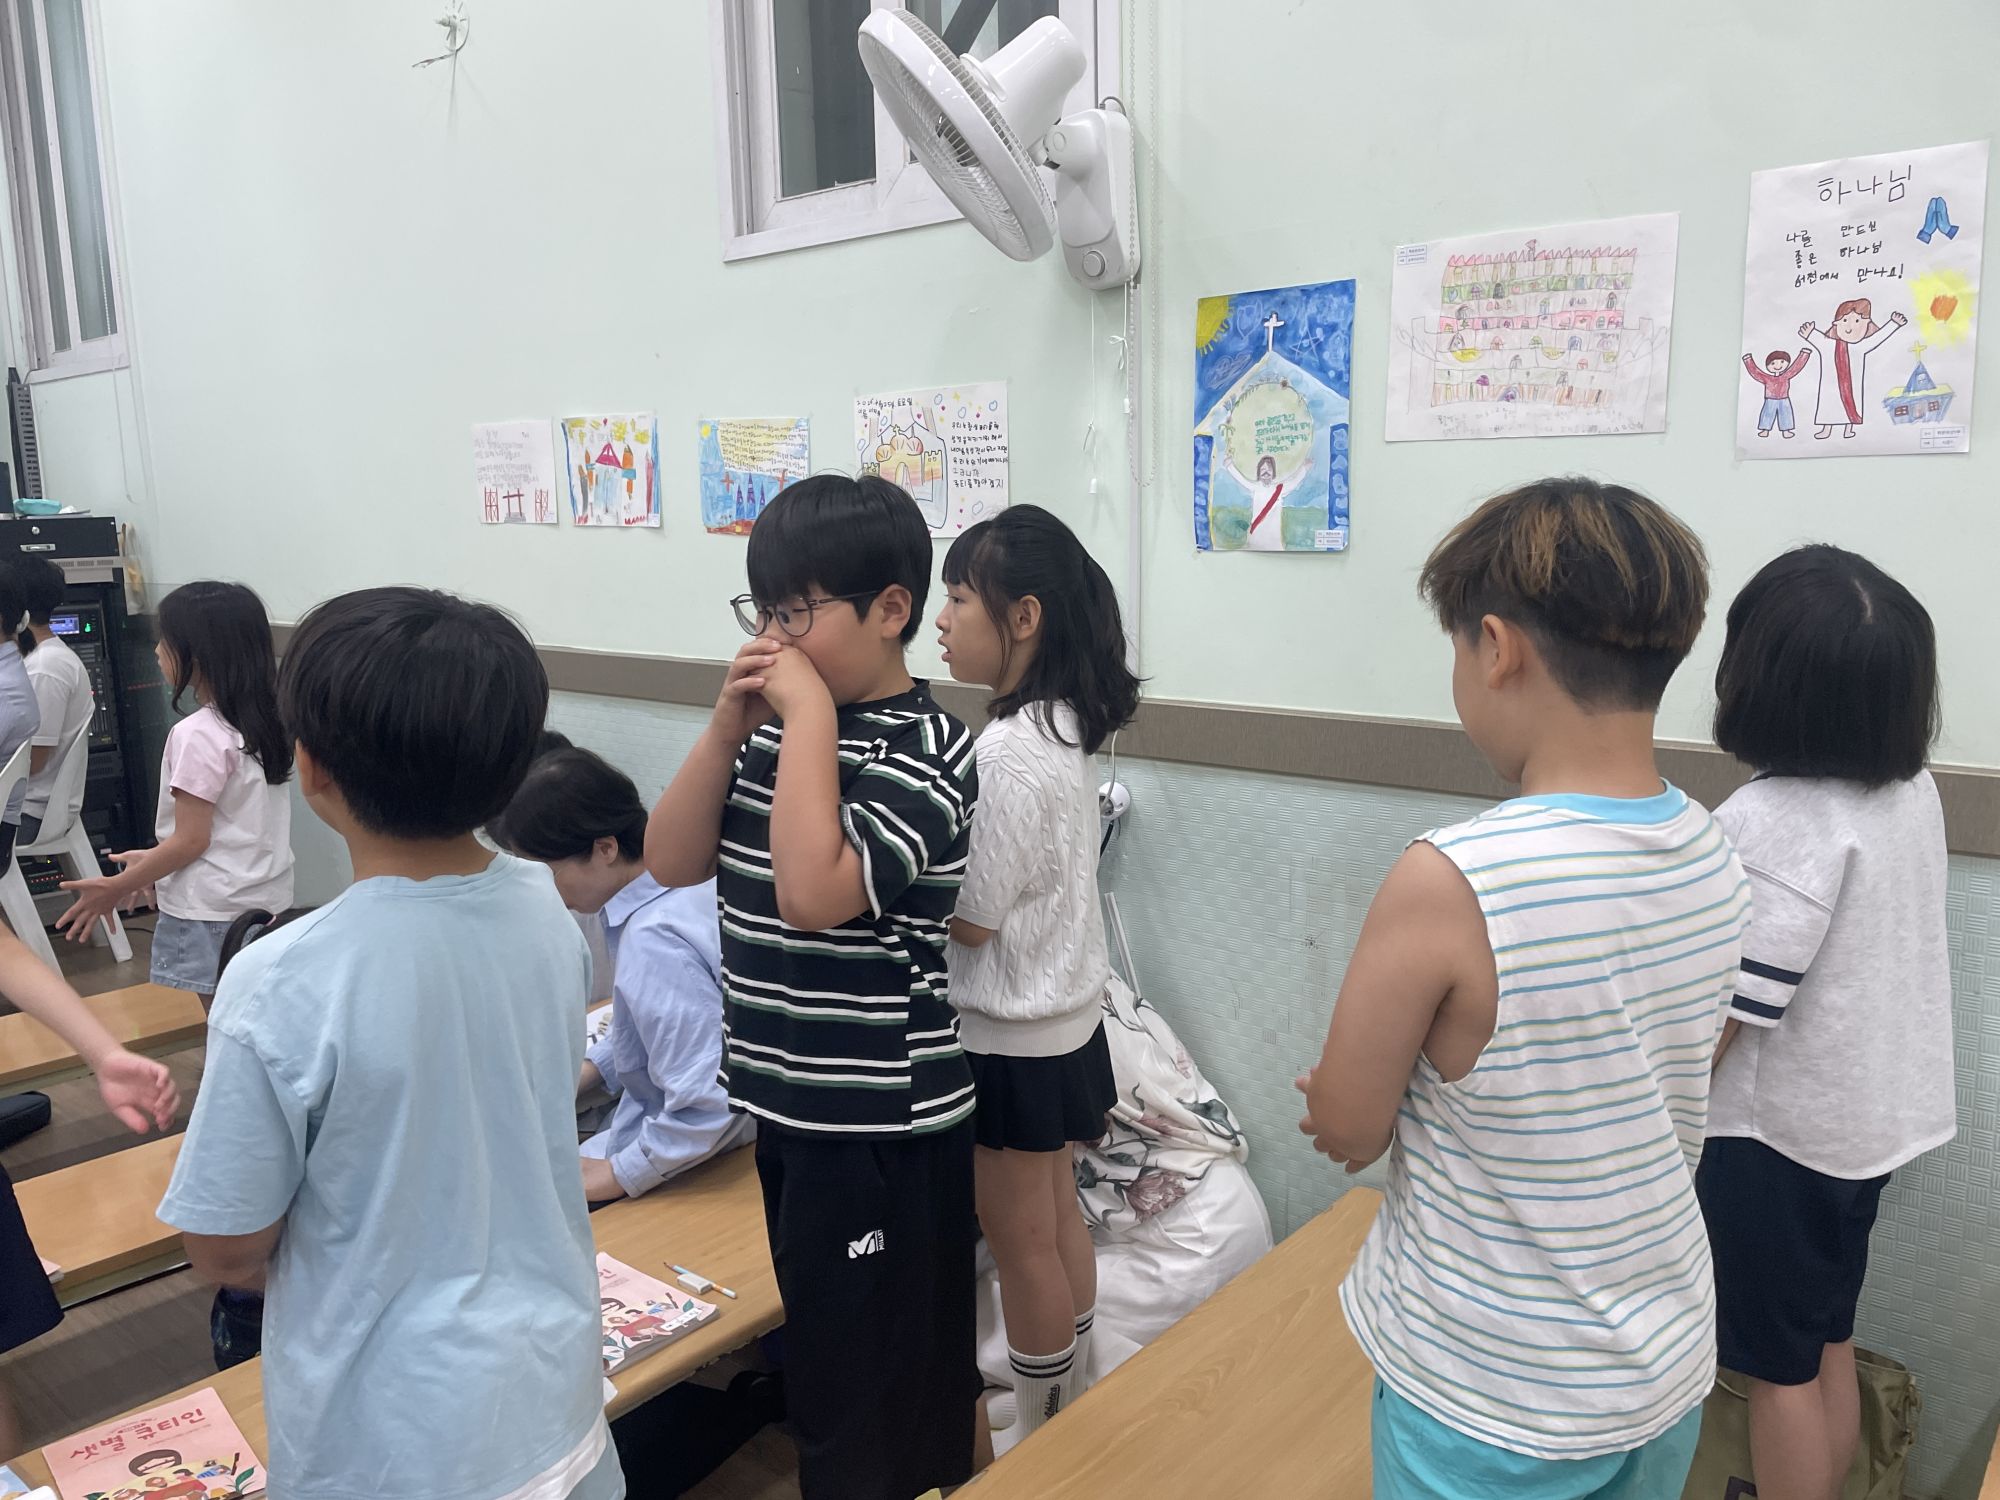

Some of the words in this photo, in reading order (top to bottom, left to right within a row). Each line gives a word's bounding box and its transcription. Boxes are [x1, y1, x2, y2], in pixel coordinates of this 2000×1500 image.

[1817, 164, 1911, 205] 하나님
[1786, 229, 1813, 248] 나를
[1840, 220, 1877, 238] 만드신
[1794, 249, 1818, 269] 좋은
[1839, 240, 1882, 258] 하나님
[1856, 263, 1904, 283] 만나요!
[69, 1434, 127, 1460] 샛별
[134, 1408, 206, 1441] 큐티인
